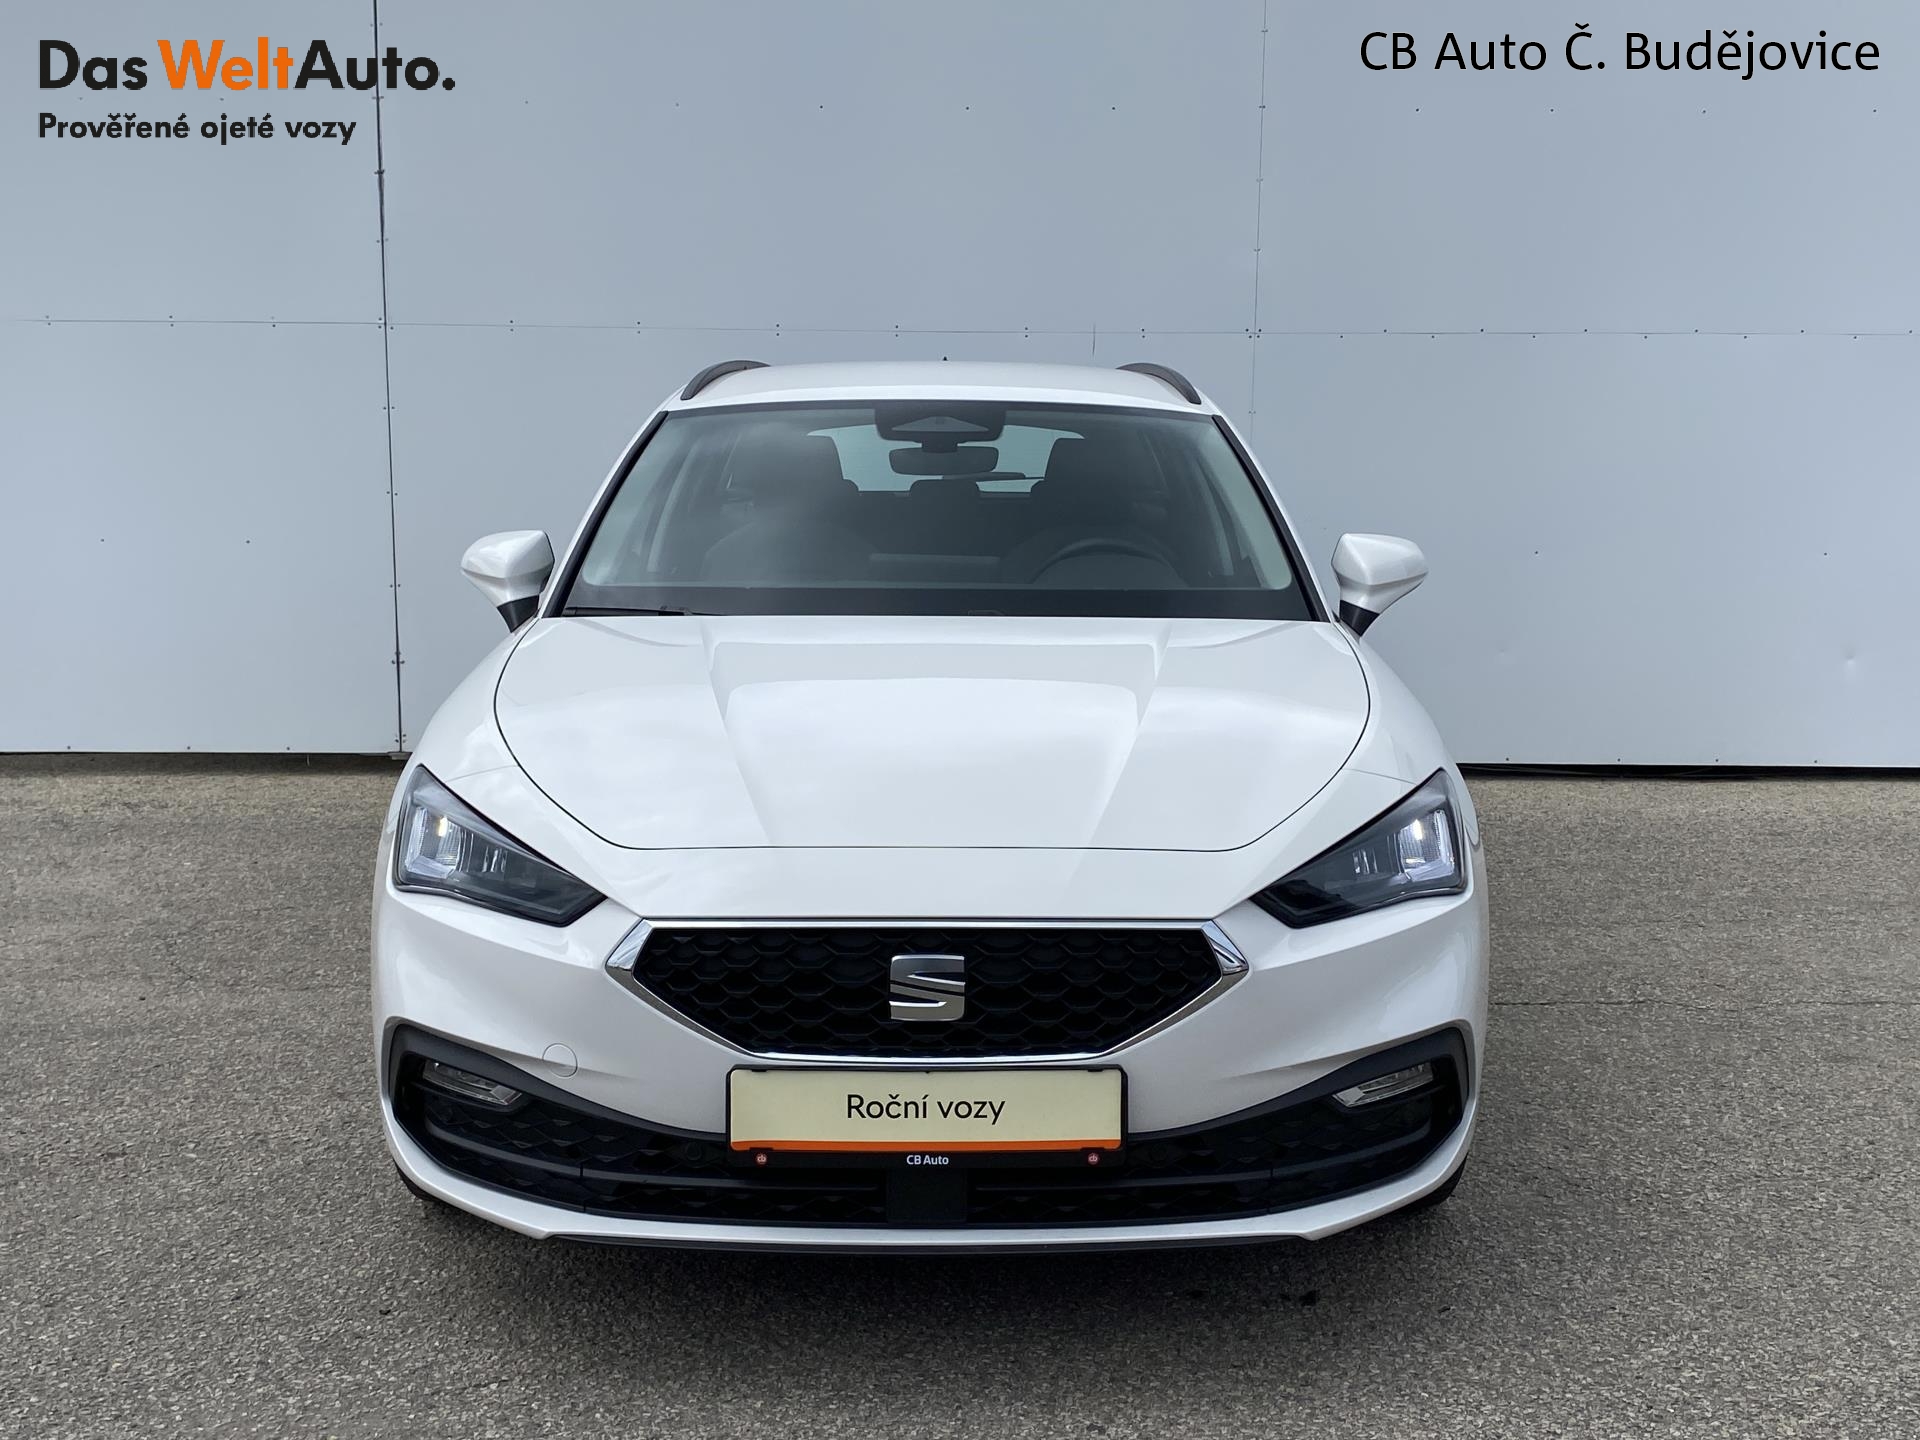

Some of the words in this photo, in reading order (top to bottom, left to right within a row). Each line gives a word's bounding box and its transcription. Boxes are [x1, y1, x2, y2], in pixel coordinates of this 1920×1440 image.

[847, 1093, 930, 1119] Roční
[936, 1100, 1006, 1126] vozy
[906, 1154, 922, 1165] CB
[923, 1154, 949, 1165] Auto
